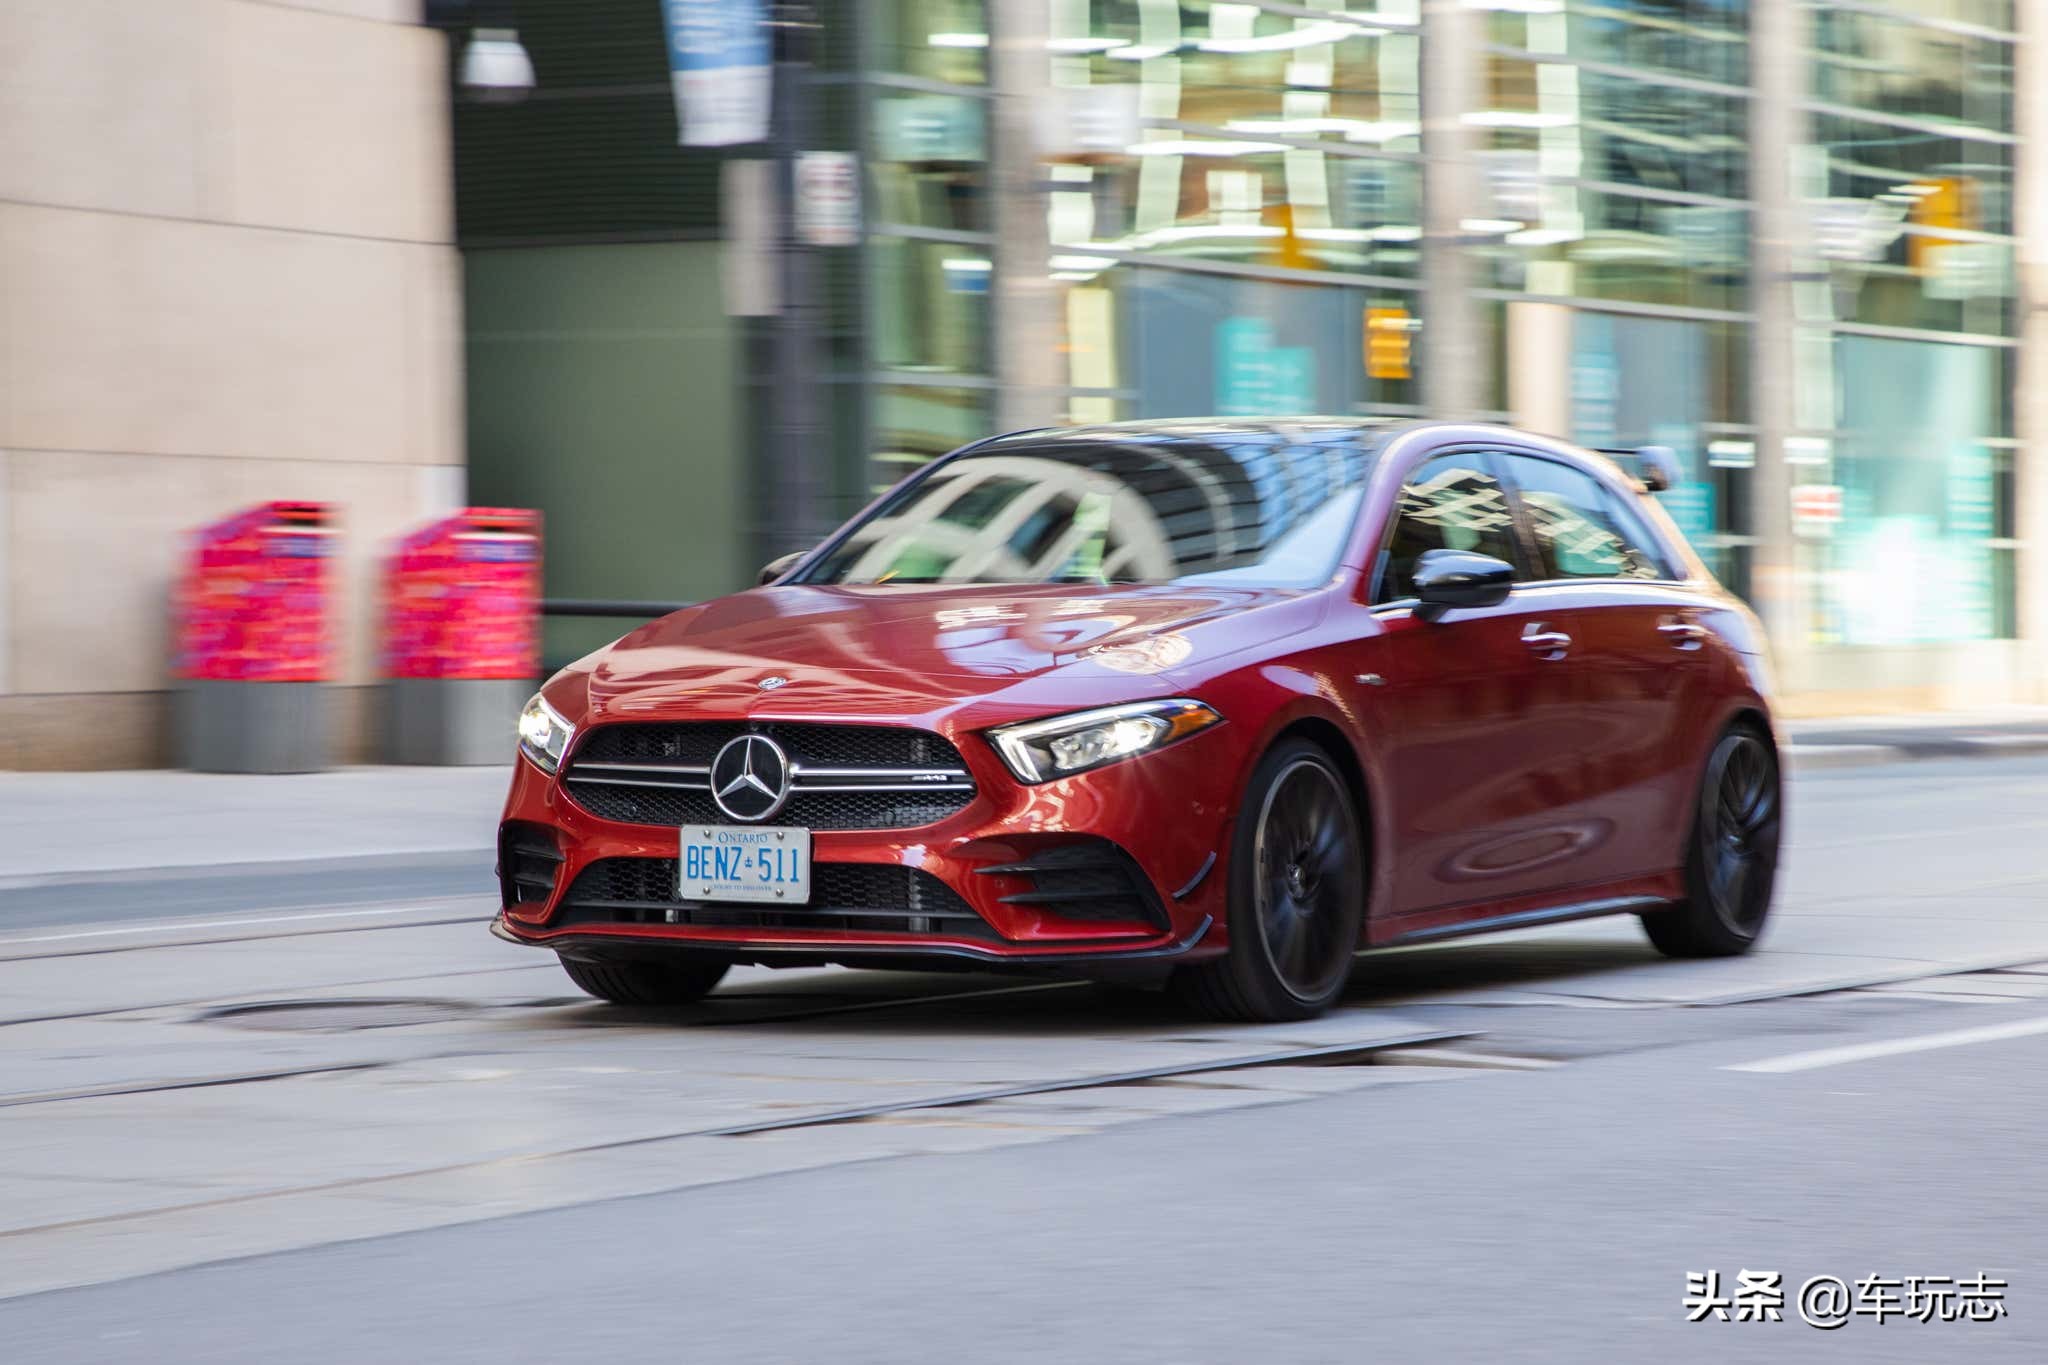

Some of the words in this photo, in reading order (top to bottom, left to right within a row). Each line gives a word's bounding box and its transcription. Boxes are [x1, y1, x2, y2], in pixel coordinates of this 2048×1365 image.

[718, 831, 768, 843] ONTARIO
[687, 845, 742, 880] BENZ
[758, 848, 800, 882] 511
